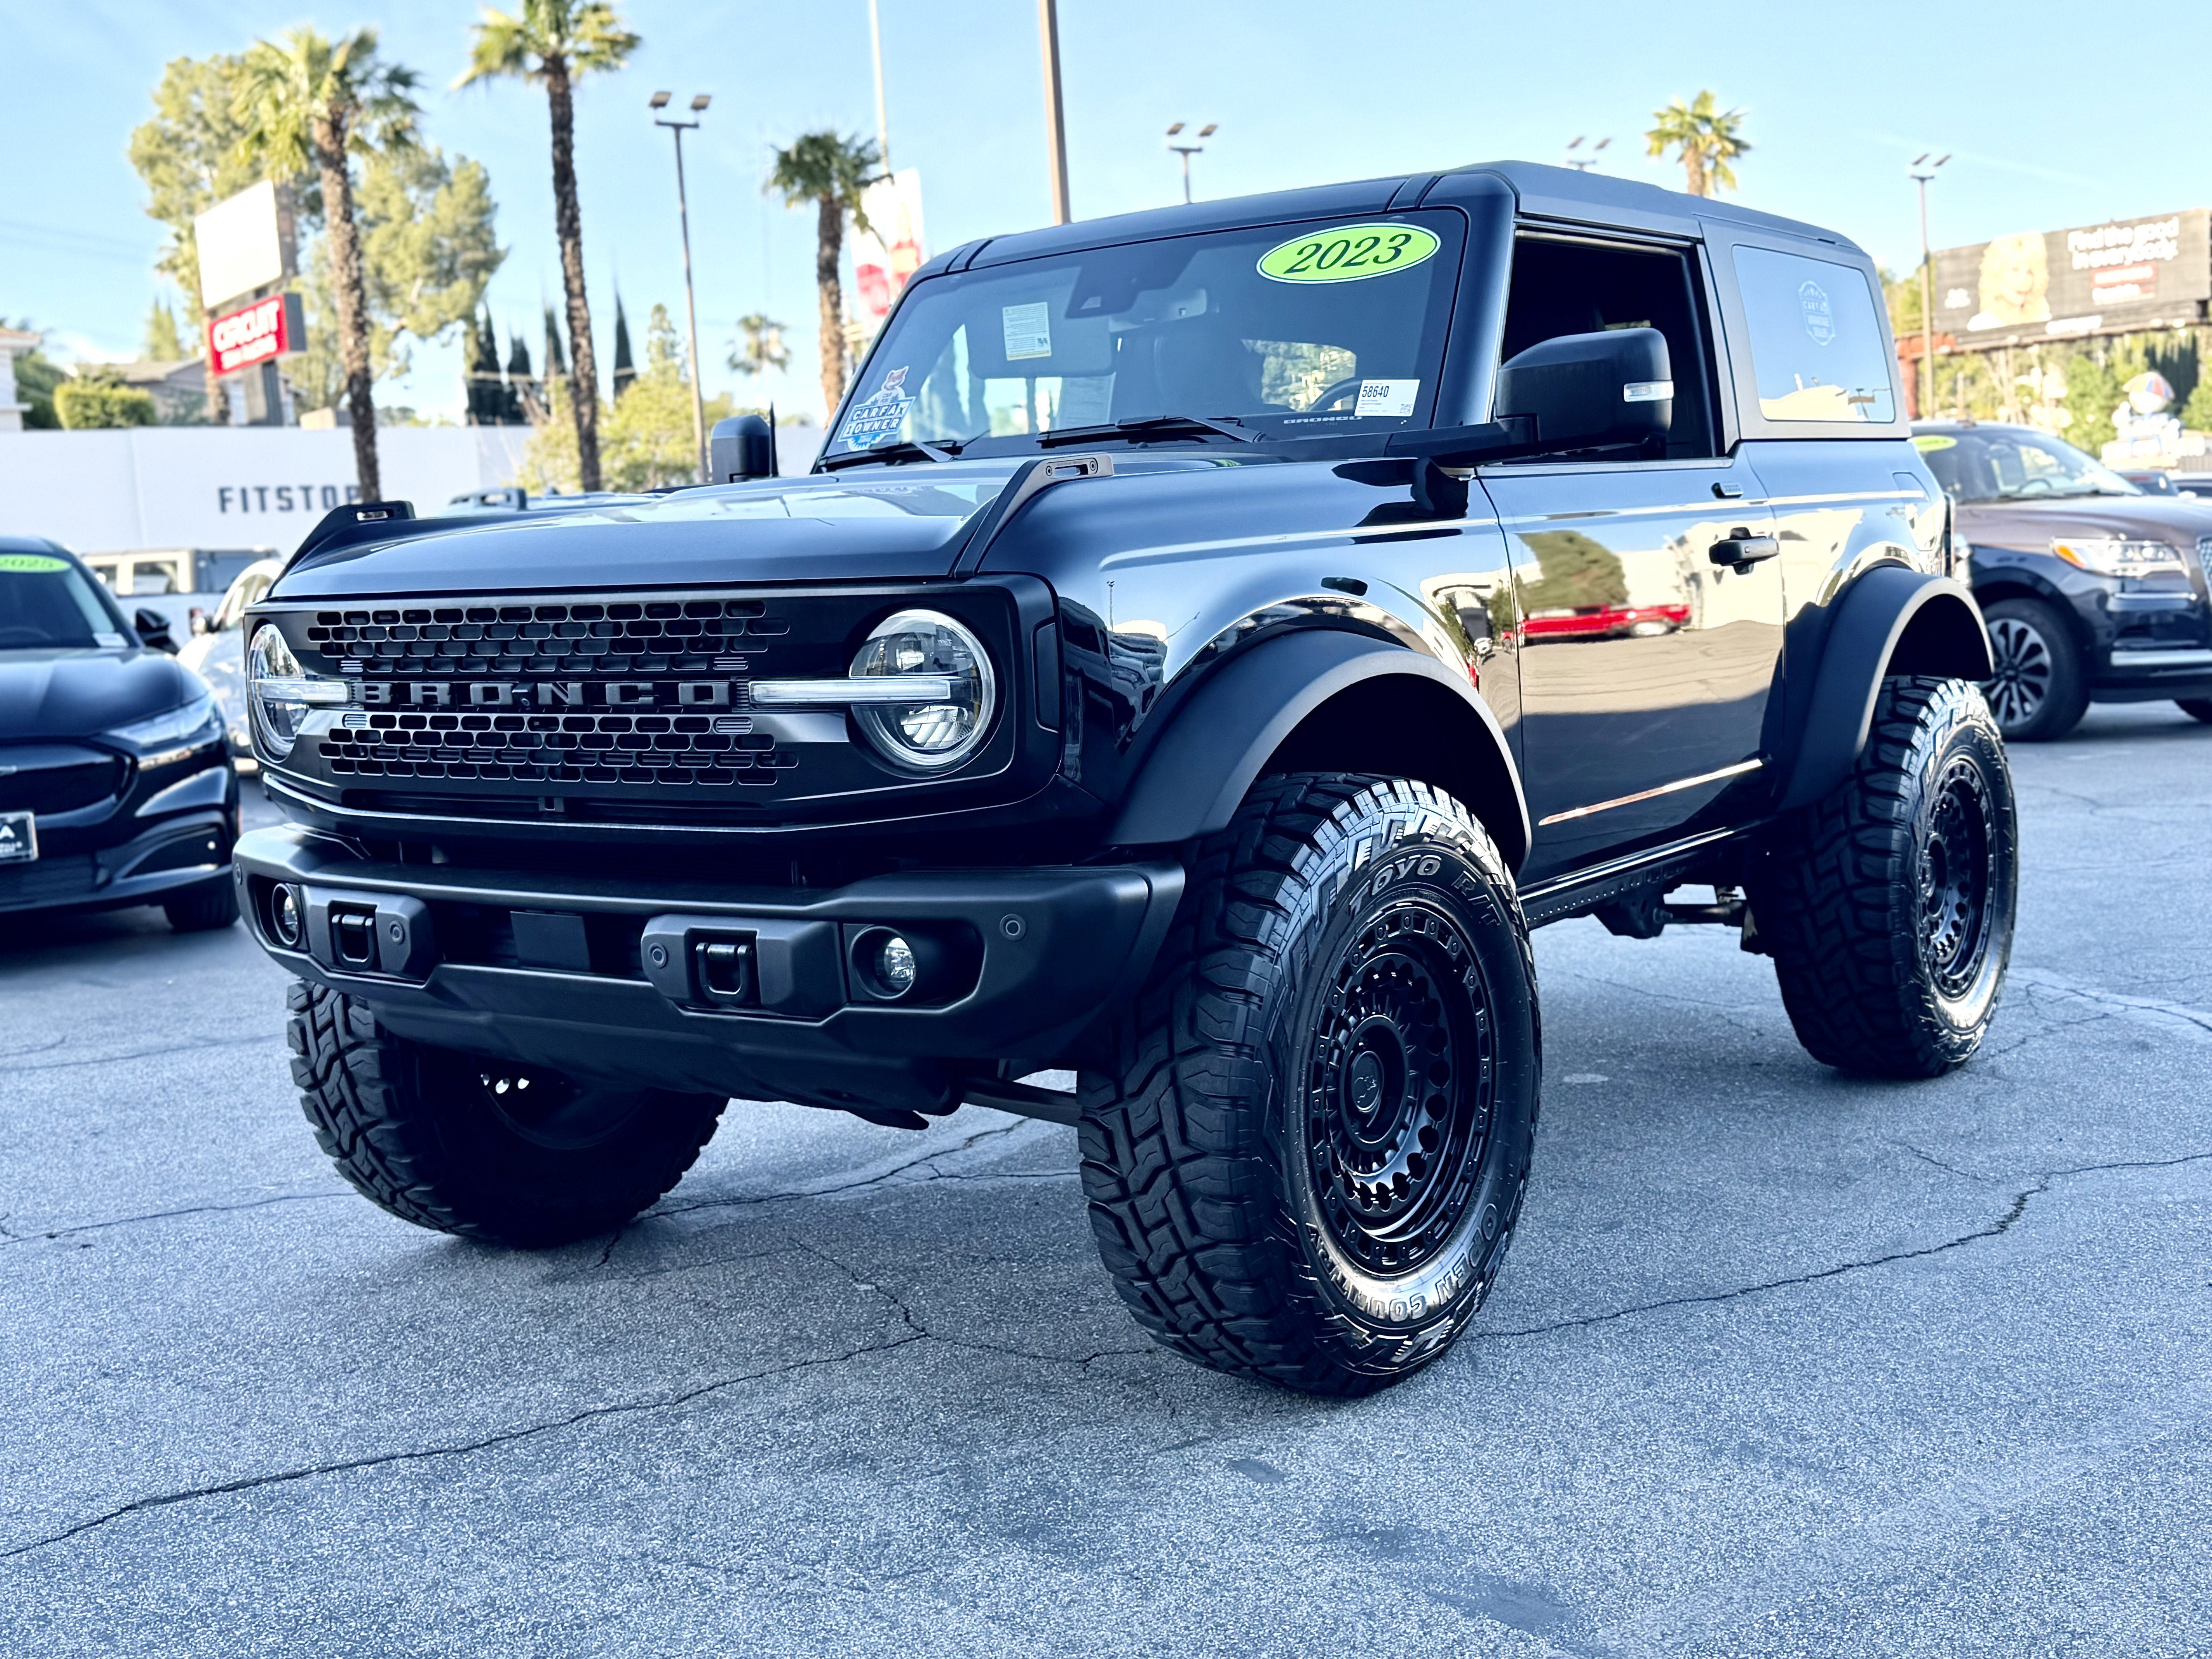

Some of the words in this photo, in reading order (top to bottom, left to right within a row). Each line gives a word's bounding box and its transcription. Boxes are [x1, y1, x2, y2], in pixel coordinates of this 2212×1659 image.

[2068, 227, 2104, 252] Find
[2104, 225, 2133, 247] the
[2133, 216, 2179, 248] good
[1283, 234, 1412, 274] 2023
[214, 300, 280, 352] CIRCUIT
[1362, 386, 1389, 397] 58640
[853, 404, 908, 421] CARFAX
[353, 681, 731, 706] BRONCO
[1349, 855, 1442, 915] TOYO
[1451, 871, 1502, 926] R/T
[1434, 1202, 1498, 1307] OPEN
